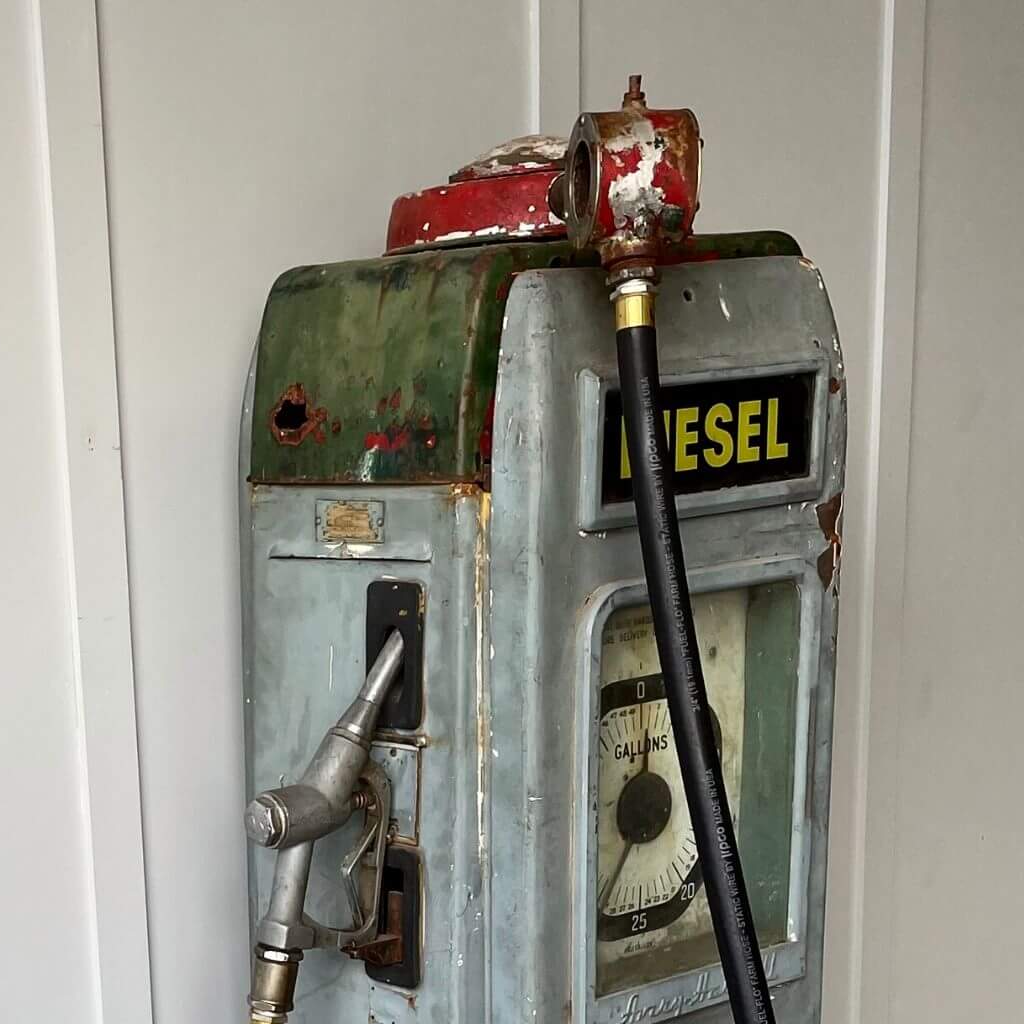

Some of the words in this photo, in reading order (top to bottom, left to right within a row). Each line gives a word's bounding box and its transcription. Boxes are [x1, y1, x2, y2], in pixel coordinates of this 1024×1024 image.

[620, 398, 789, 479] ESEL
[636, 681, 646, 699] 0
[614, 734, 668, 760] GALLONS
[705, 767, 715, 786] USA
[680, 882, 695, 900] 20
[631, 912, 647, 931] 25
